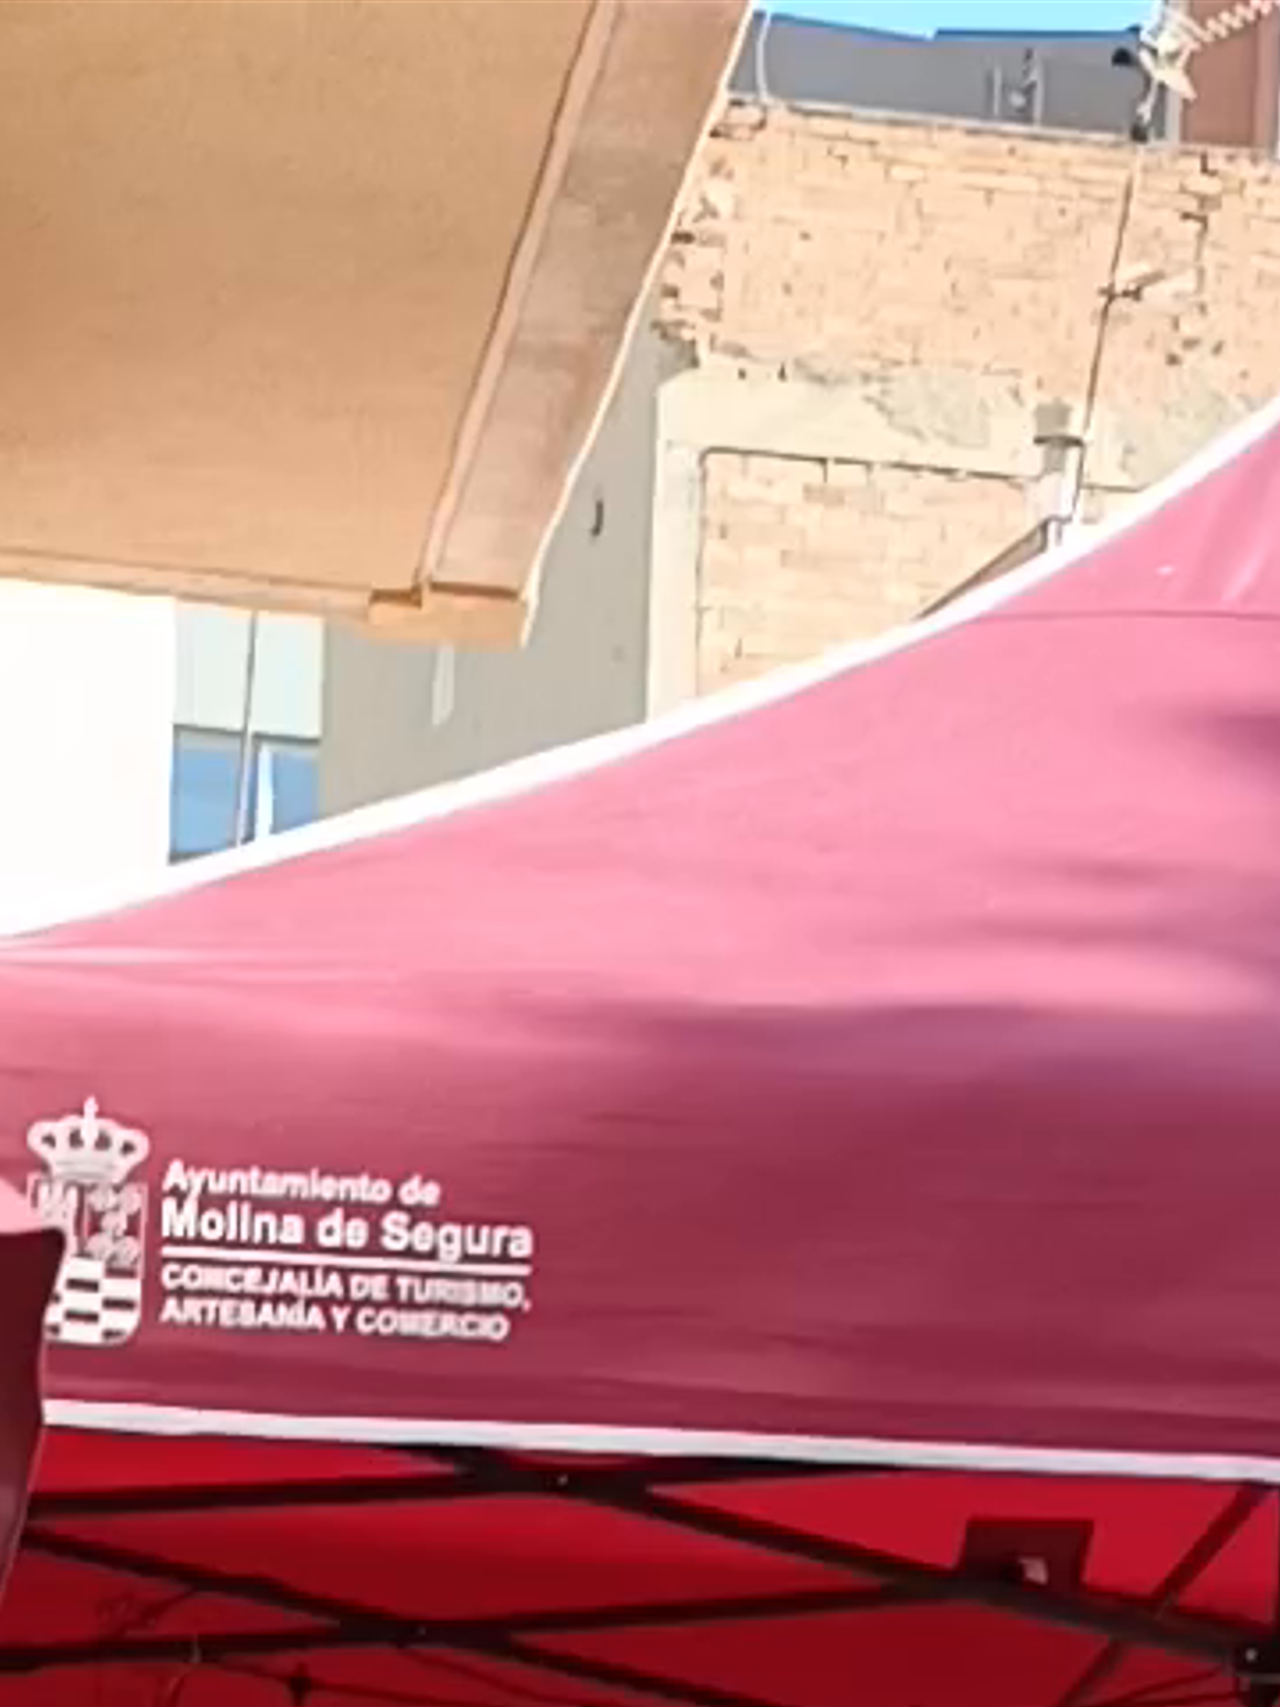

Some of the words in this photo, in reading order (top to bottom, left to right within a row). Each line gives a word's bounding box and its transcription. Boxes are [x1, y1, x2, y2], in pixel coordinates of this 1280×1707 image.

[163, 1158, 392, 1202] Ayuntamiento
[398, 1173, 441, 1206] de
[161, 1196, 305, 1244] Molina
[316, 1207, 369, 1248] de
[381, 1211, 533, 1263] Segura
[161, 1263, 344, 1298] CONCEJALÍA
[349, 1274, 390, 1300] DE
[396, 1276, 533, 1312] TURISMO,
[160, 1296, 326, 1330] ARTESANÍA
[329, 1305, 352, 1332] Y
[356, 1307, 511, 1341] COMERCIO
